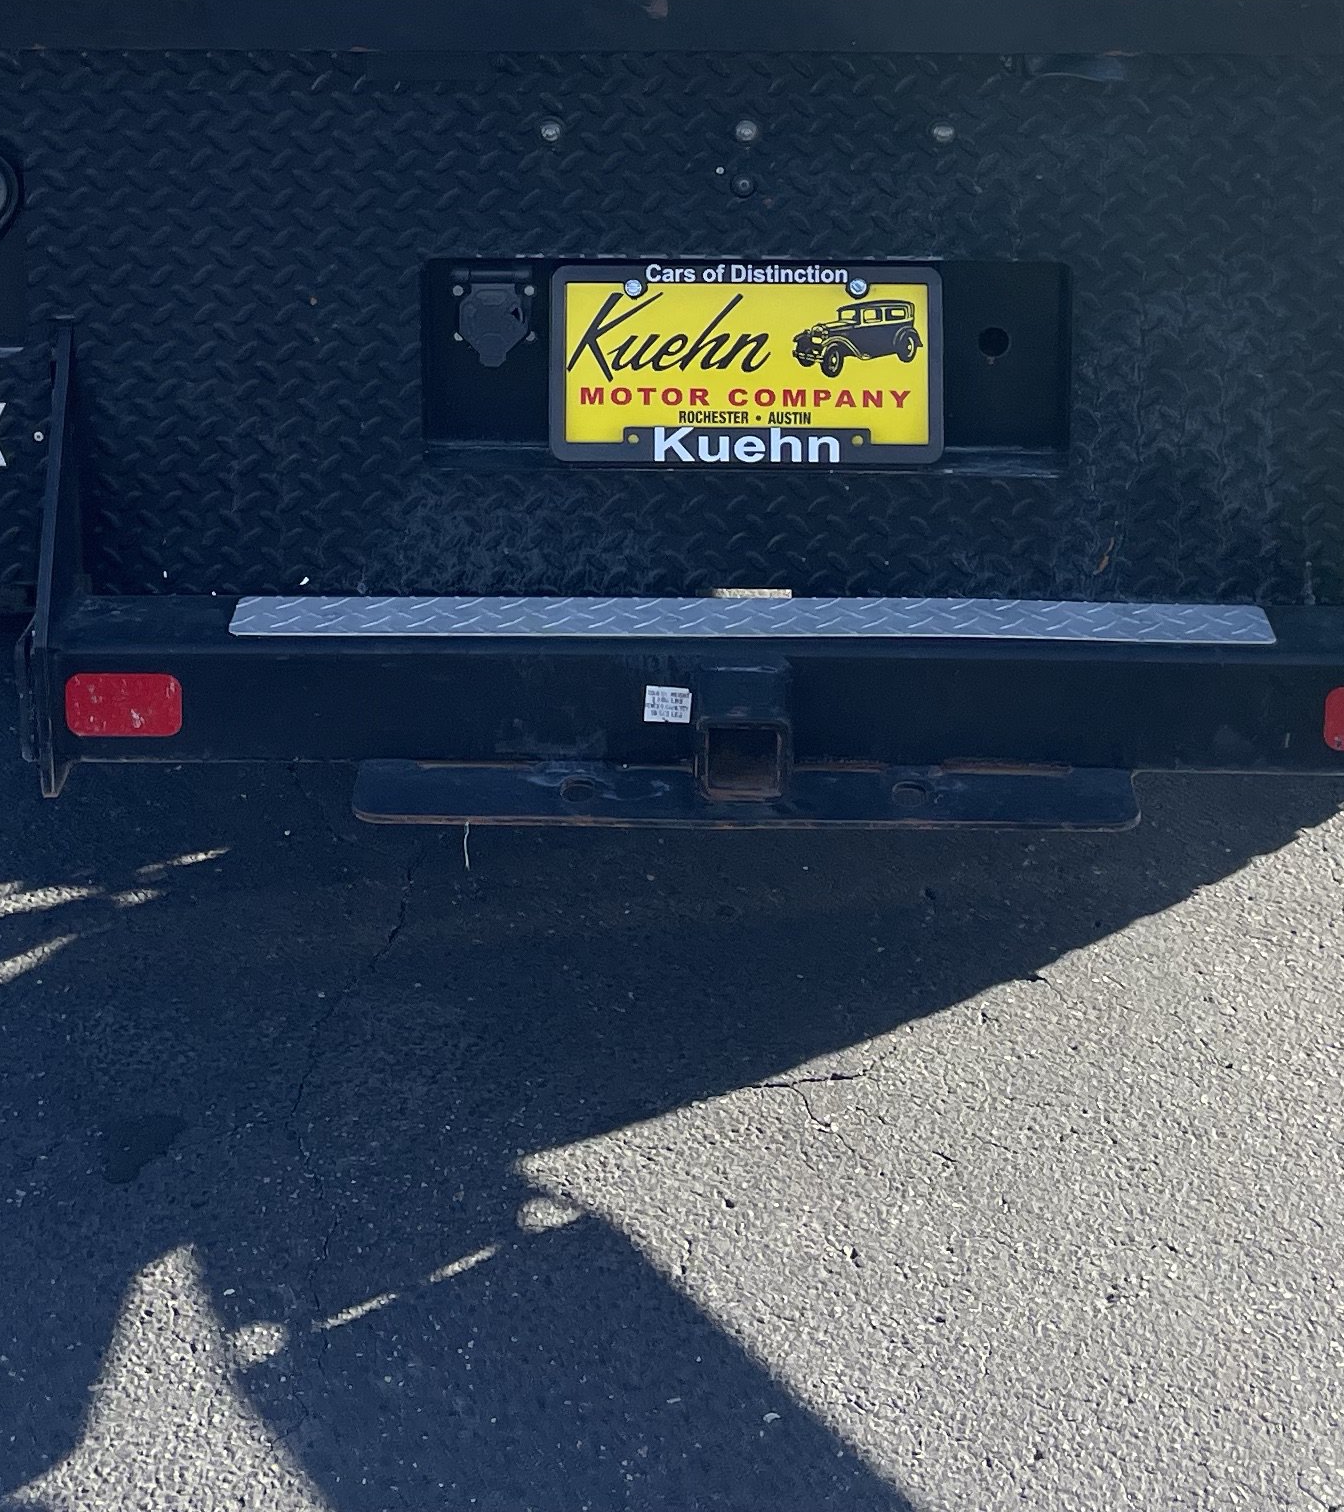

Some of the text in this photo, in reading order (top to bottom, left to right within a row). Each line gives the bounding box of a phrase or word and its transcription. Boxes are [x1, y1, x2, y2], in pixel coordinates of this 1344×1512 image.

[645, 263, 849, 285] Cars of Distinction
[566, 291, 772, 383] Kuehn
[579, 386, 912, 409] MOTOR COMPANY
[678, 410, 812, 426] ROCHESTER AUSTIN
[653, 426, 841, 464] Kuehn
